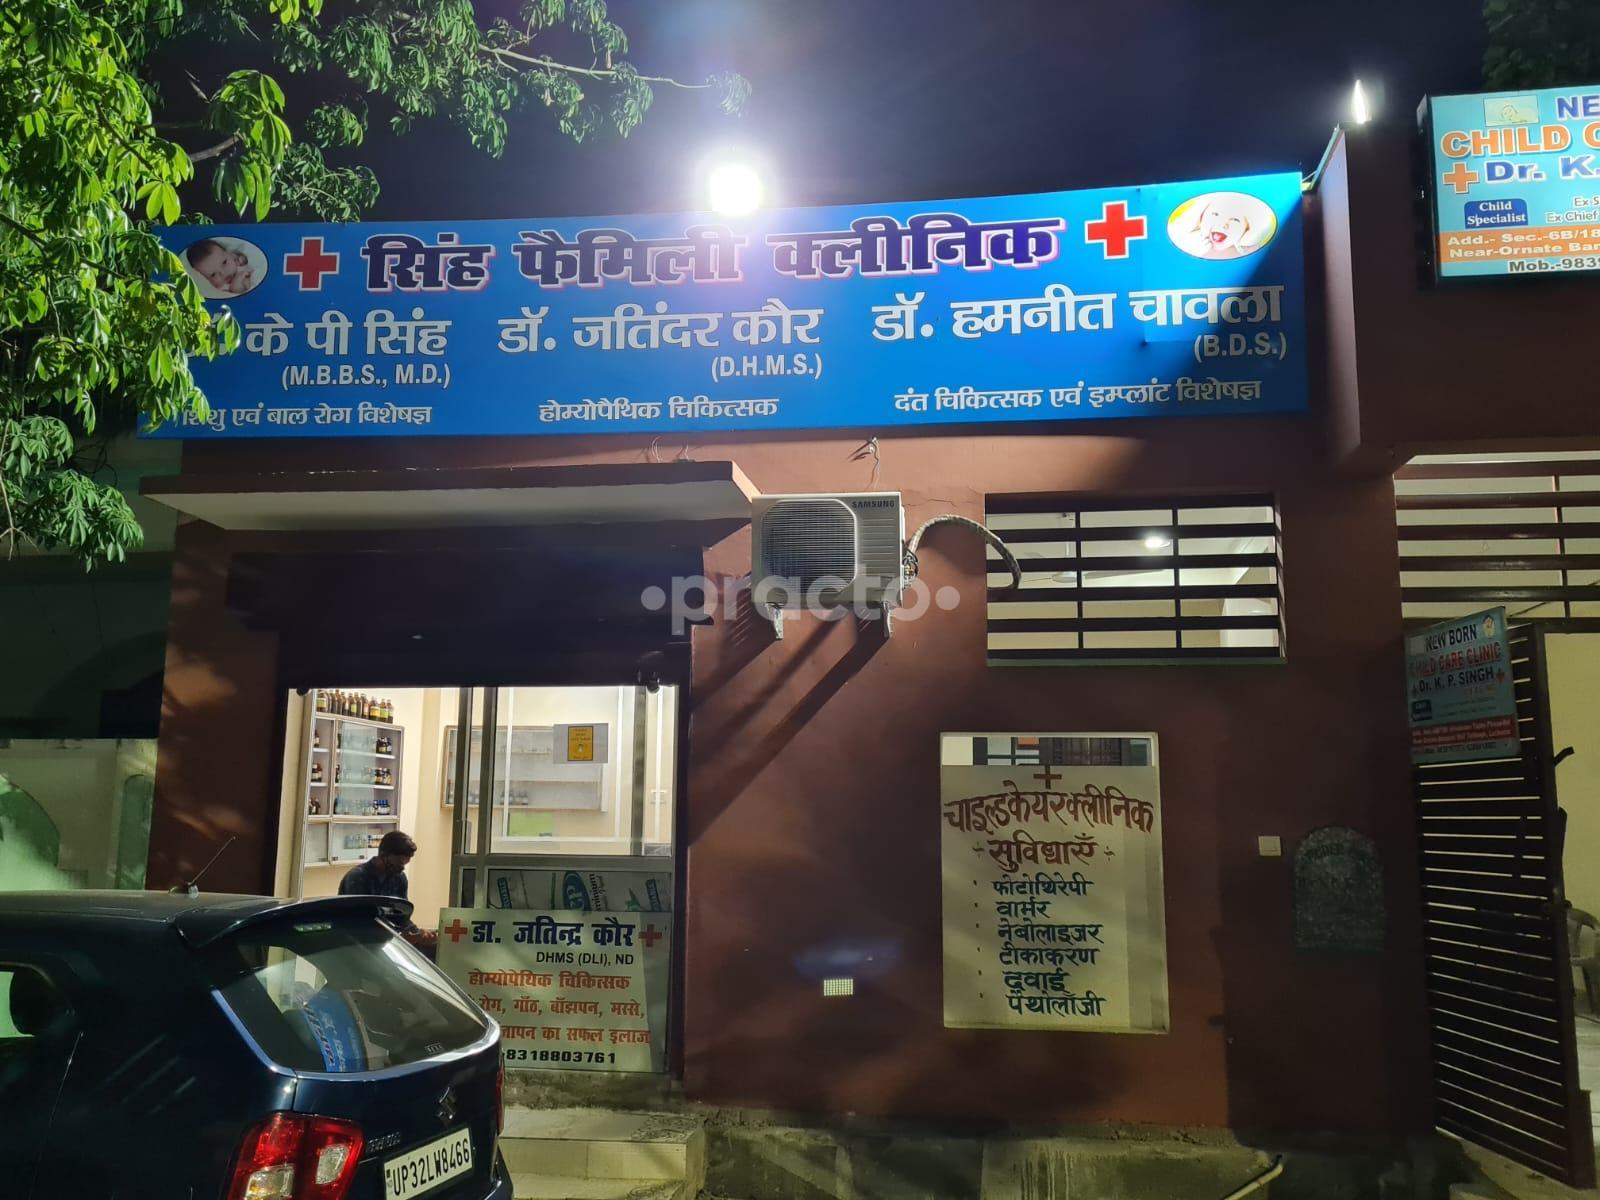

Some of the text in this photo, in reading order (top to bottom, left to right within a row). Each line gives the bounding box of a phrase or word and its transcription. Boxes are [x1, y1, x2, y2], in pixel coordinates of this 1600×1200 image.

[1441, 124, 1571, 158] CHILD
[1485, 161, 1545, 183] Dr.
[1479, 201, 1513, 212] Child
[1547, 210, 1598, 222] Ex Chief
[1574, 197, 1589, 207] Ex
[1467, 213, 1526, 226] Specialist
[360, 213, 1065, 292] सिंह फैमिली क्लीनिक
[1509, 256, 1600, 272] Mob.-983
[497, 297, 825, 353] डॉ. जतिंदर कौर
[871, 283, 1285, 341] डॉ. हमनीत चावला
[245, 312, 294, 356] के
[305, 309, 353, 356] पी
[363, 307, 452, 356] सिंह
[1193, 332, 1287, 363] (B.D.S.)
[282, 363, 451, 390] (M.B.B.S., M.D.)
[711, 353, 823, 383] (D.H.M.S.)
[894, 388, 929, 411] दंत
[934, 386, 1044, 410] चिकित्सक
[1049, 381, 1085, 408] एवं
[1176, 377, 1262, 402] विशेषज्ञ
[232, 402, 264, 426] एवं
[267, 407, 310, 425] बाल
[313, 403, 353, 425] रोग
[358, 402, 433, 425] विशेषज्ञ
[539, 395, 780, 423] होम्योपैथिक चिकित्सक
[851, 500, 896, 509] SAMSUNG
[1425, 624, 1478, 652] NEW BORN
[1439, 651, 1465, 671] CARE
[1466, 642, 1502, 666] CLINIC
[1458, 667, 1494, 685] SINGH
[513, 915, 584, 946] जतिन्द्र
[592, 917, 636, 946] कौर
[536, 952, 574, 964] DHMS
[615, 954, 634, 965] ND
[506, 1049, 616, 1064] 8318803761
[392, 1137, 470, 1196] UP32LW8466
